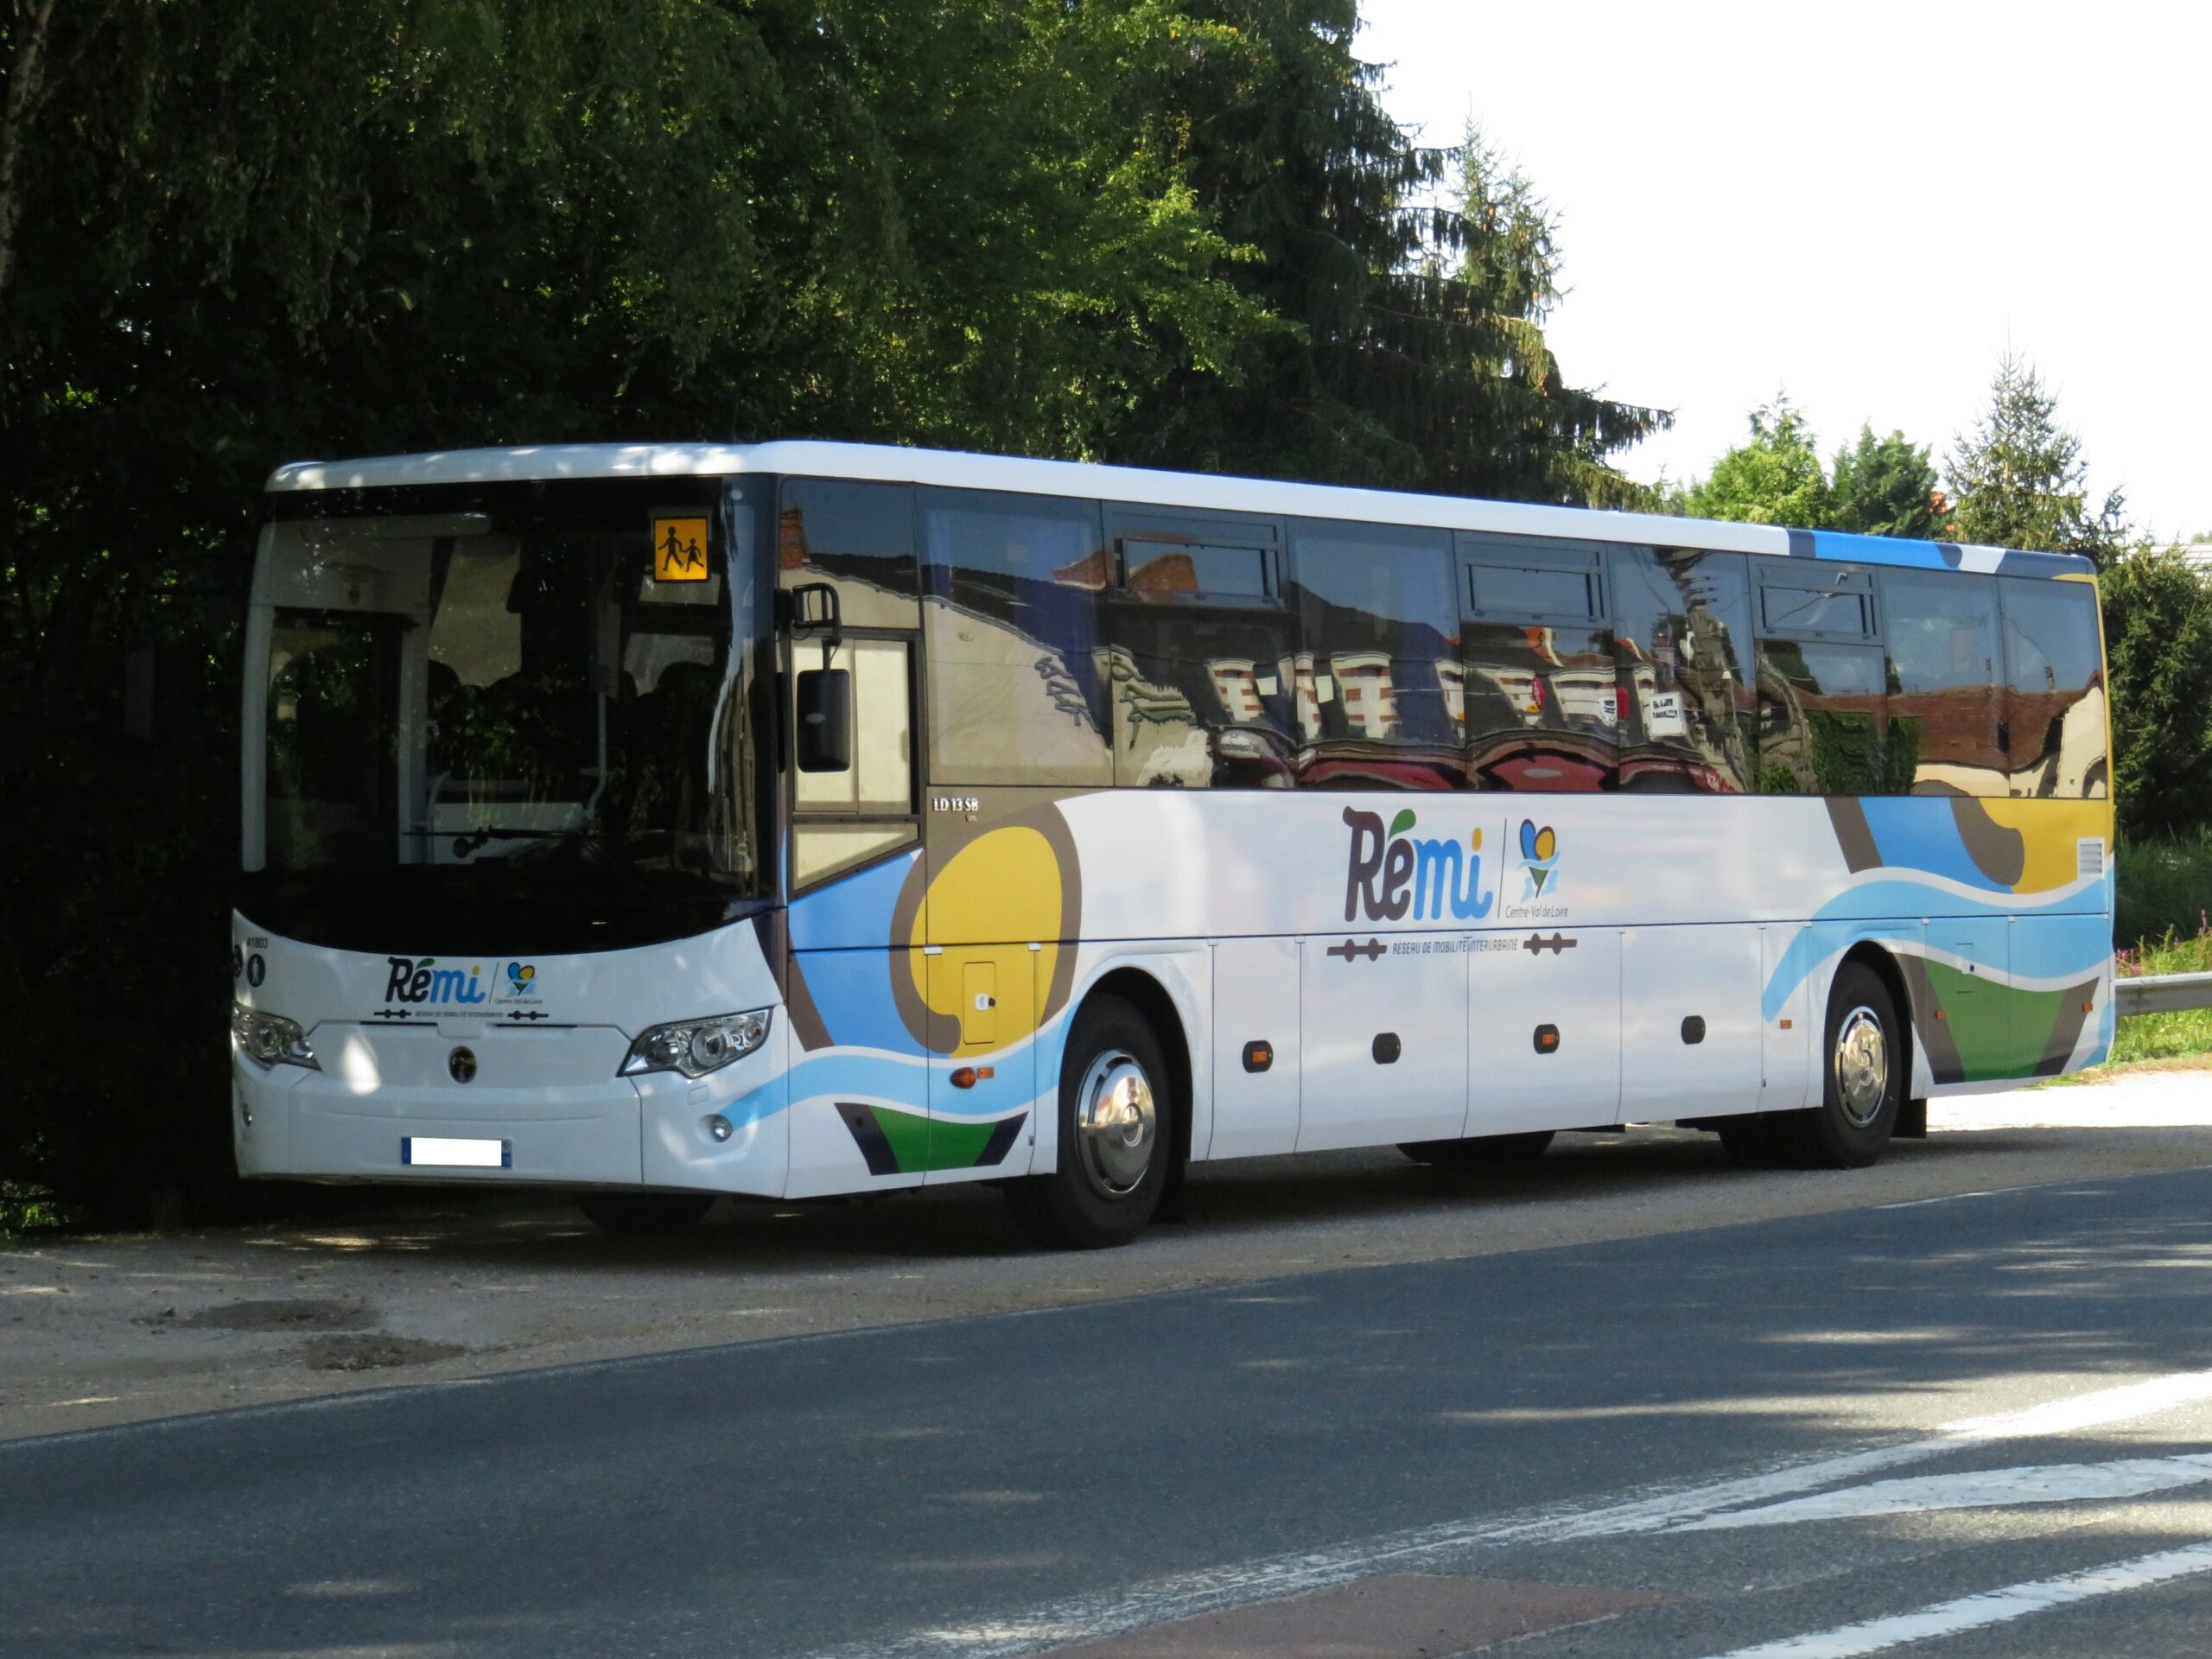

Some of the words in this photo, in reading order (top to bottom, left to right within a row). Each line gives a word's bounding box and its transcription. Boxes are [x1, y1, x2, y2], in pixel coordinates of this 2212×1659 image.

[933, 798, 949, 811] LD
[951, 798, 963, 811] 13
[1343, 806, 1493, 922] Rémi
[1422, 941, 1432, 954] DE
[385, 957, 486, 1003] Rémi
